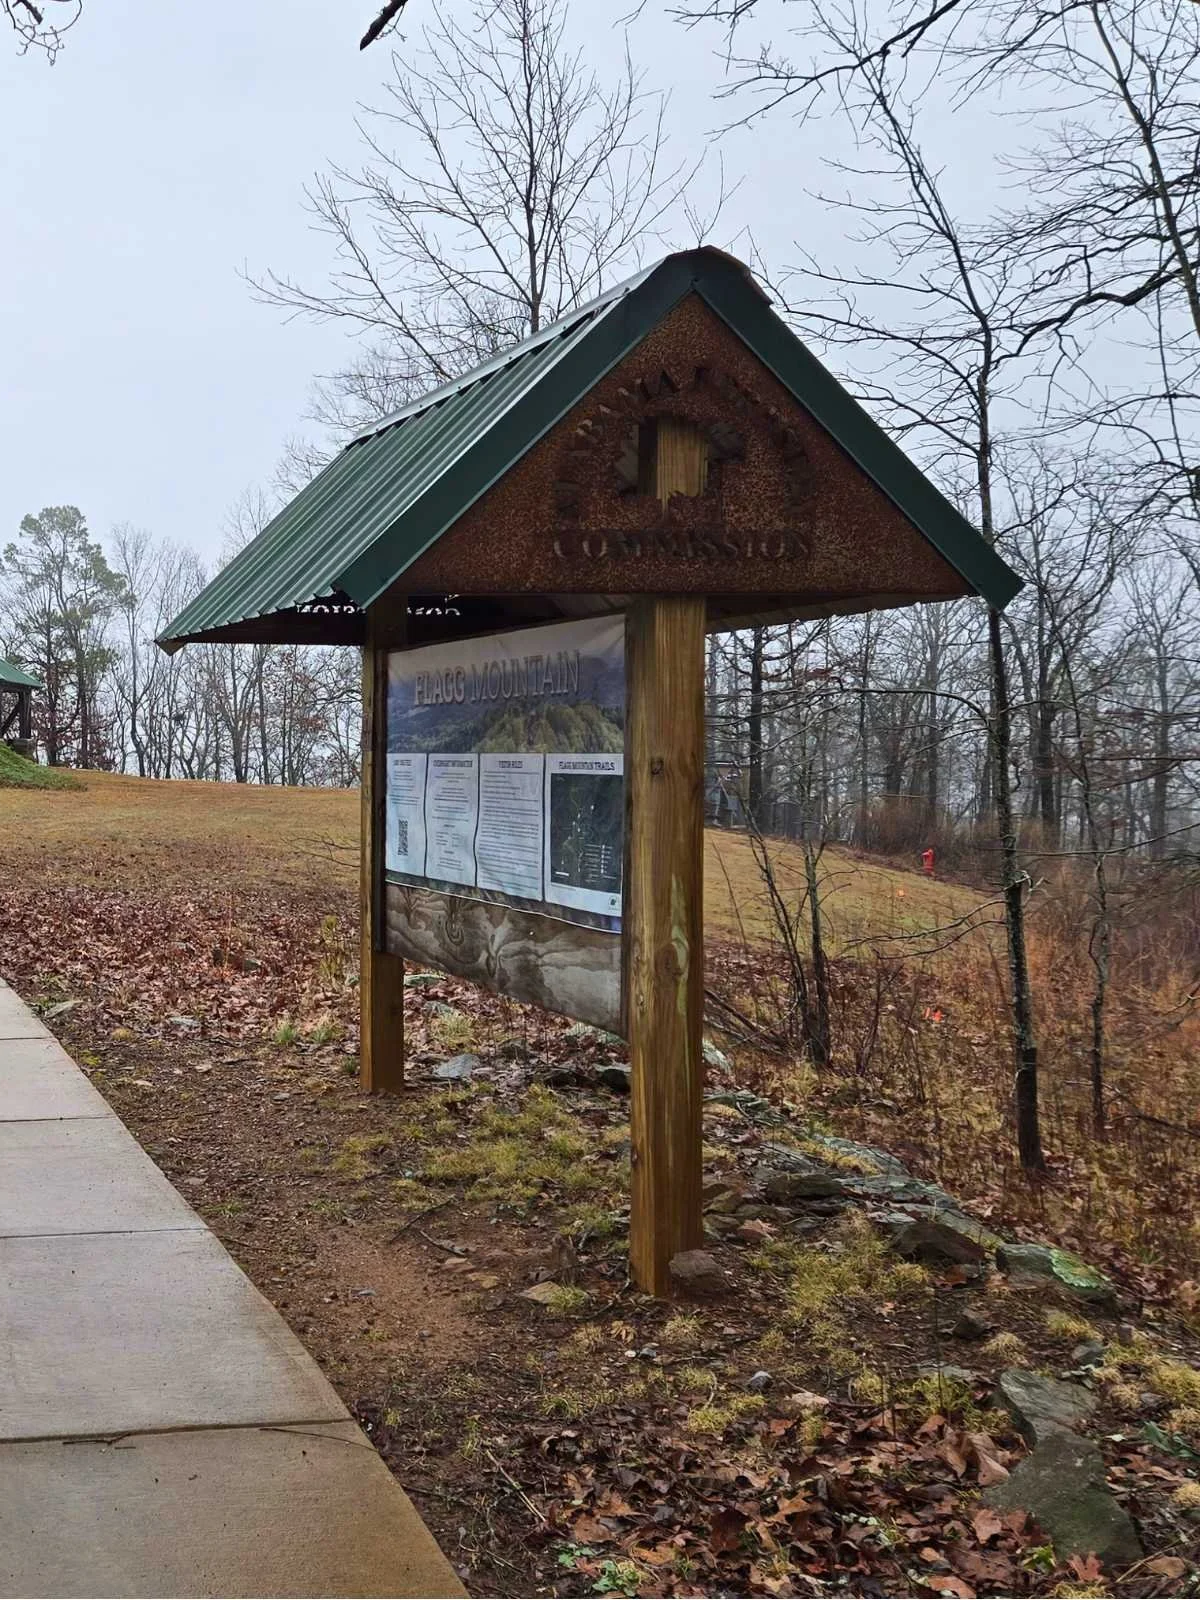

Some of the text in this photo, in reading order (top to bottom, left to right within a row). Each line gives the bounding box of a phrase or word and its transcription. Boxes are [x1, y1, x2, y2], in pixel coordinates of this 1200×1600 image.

[552, 529, 811, 559] COMMISSION
[414, 649, 581, 706] FLAGG MOUNTAIN
